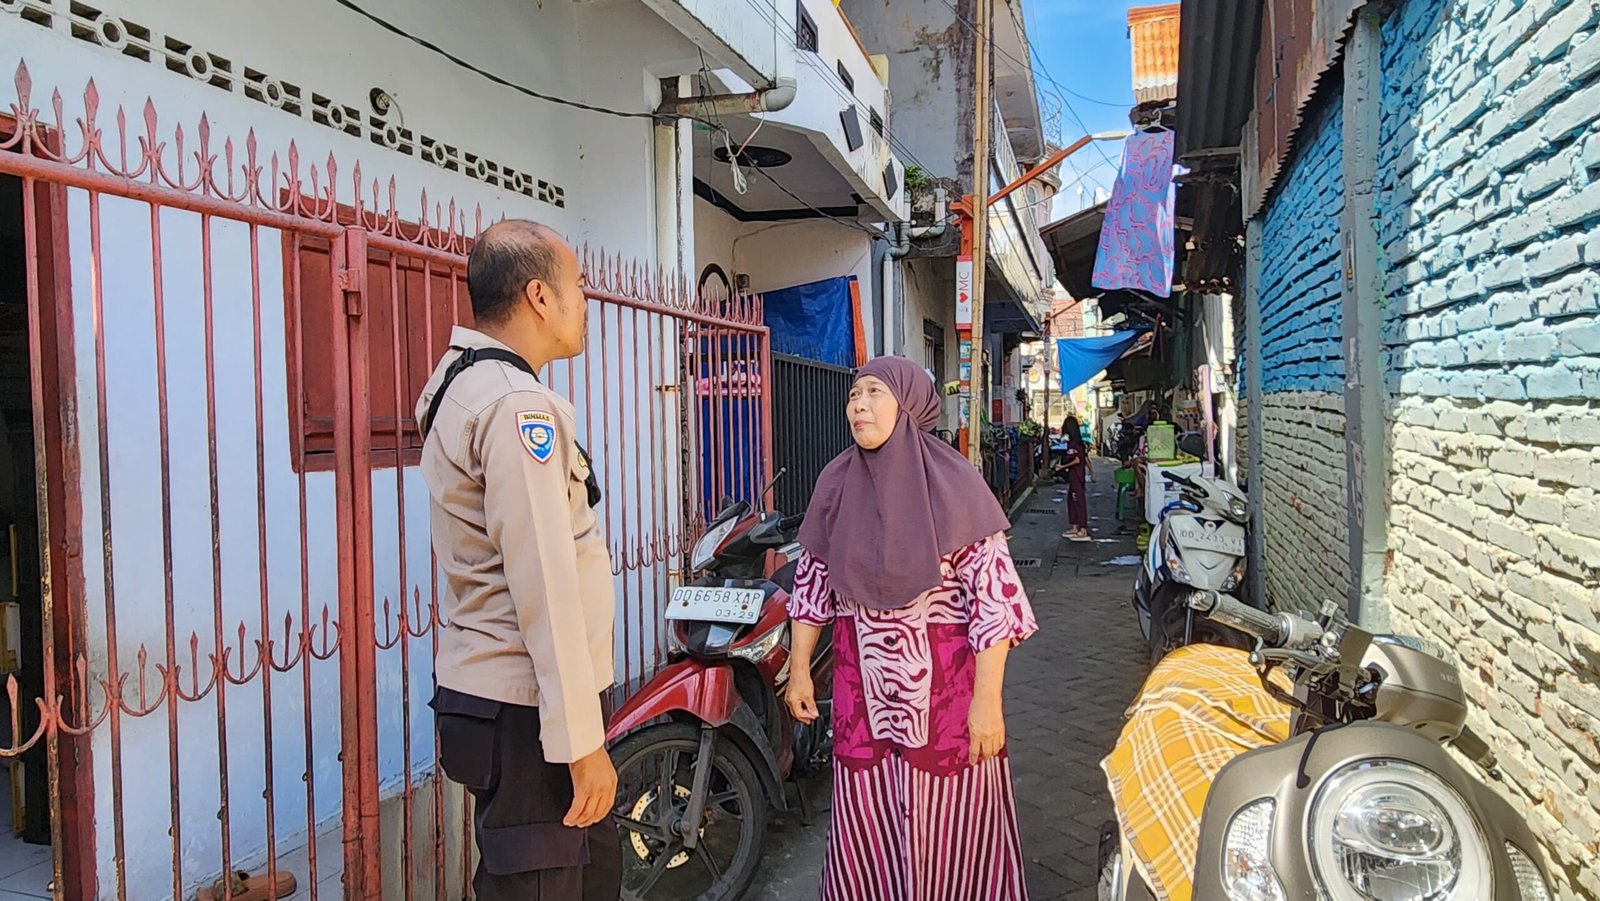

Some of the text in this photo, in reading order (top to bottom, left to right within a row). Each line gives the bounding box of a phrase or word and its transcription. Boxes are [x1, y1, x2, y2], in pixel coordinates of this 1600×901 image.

[523, 413, 550, 422] BINMAS
[674, 589, 761, 605] DD 6658 XAP
